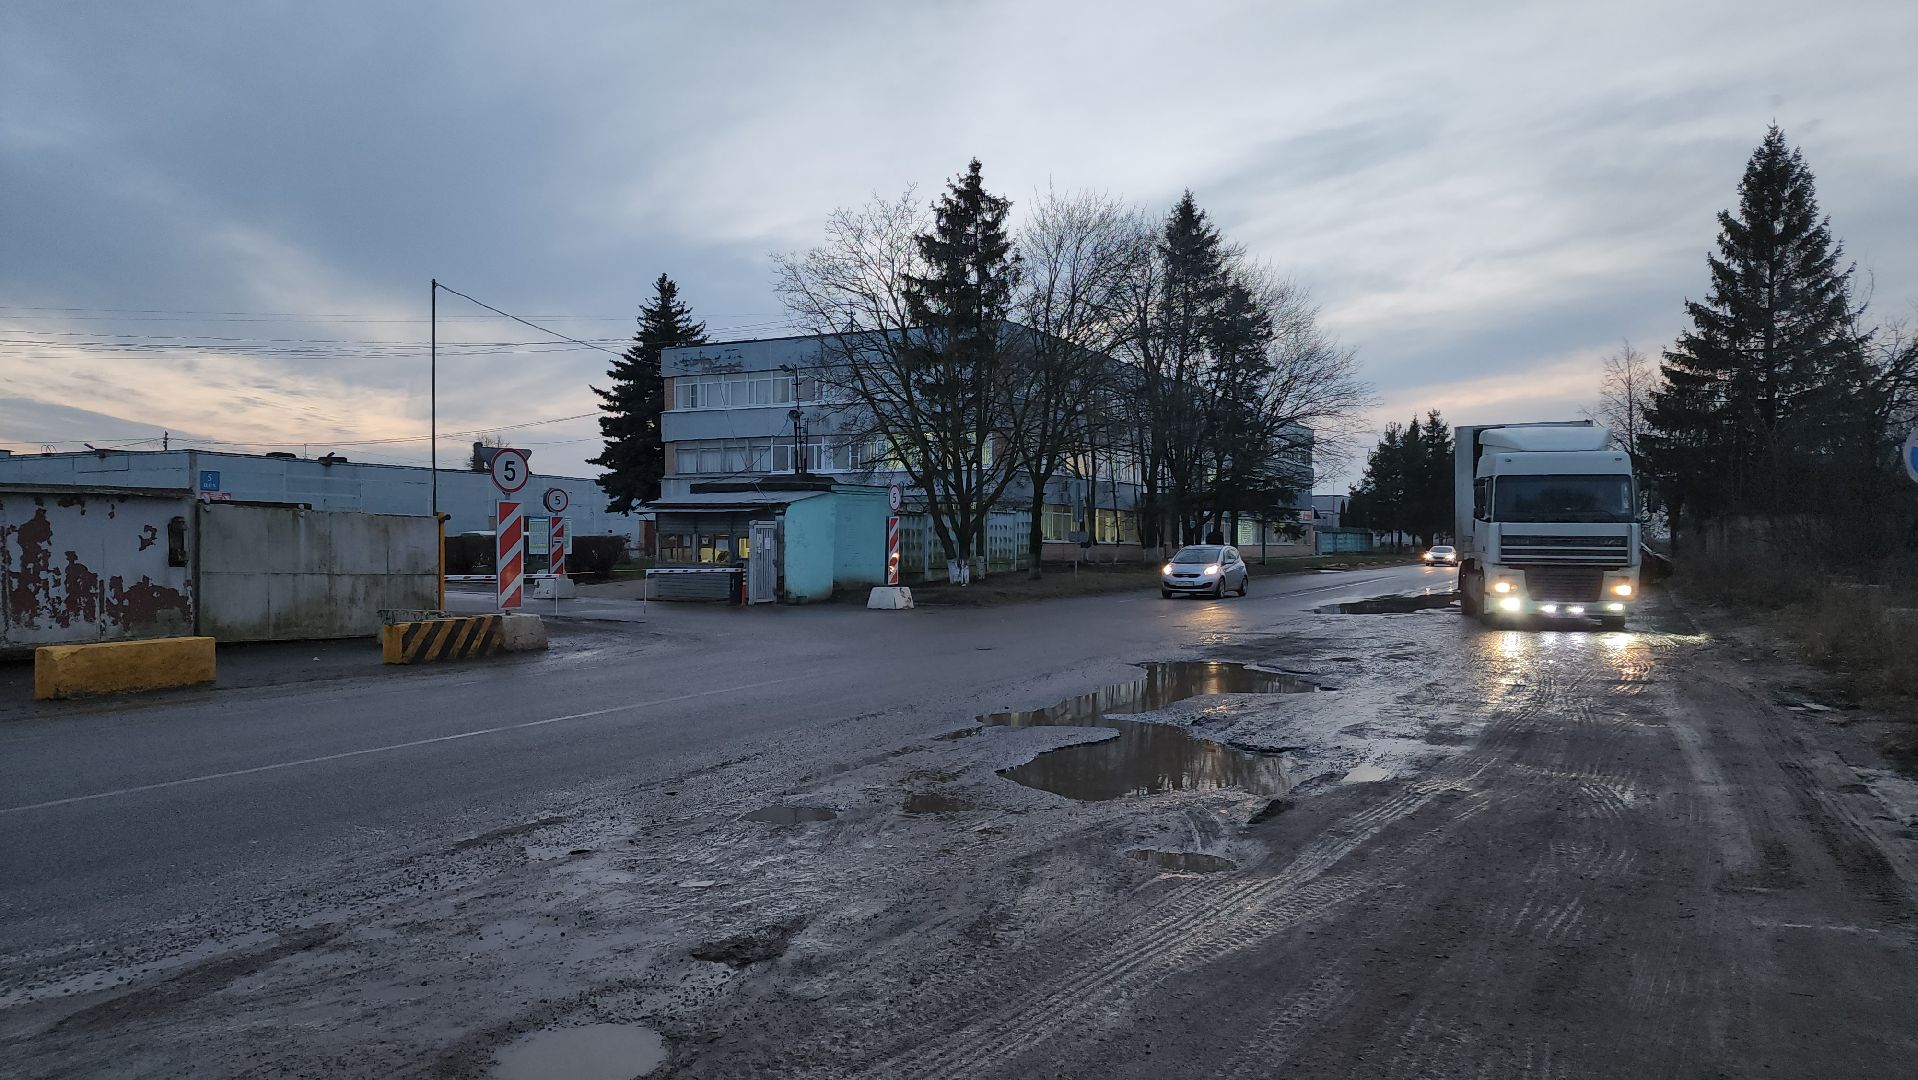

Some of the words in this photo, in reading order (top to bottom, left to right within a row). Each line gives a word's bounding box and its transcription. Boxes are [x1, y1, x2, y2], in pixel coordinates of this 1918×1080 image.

[503, 460, 516, 482] 5
[207, 473, 213, 482] 5
[554, 495, 561, 505] 5
[892, 492, 897, 504] 5
